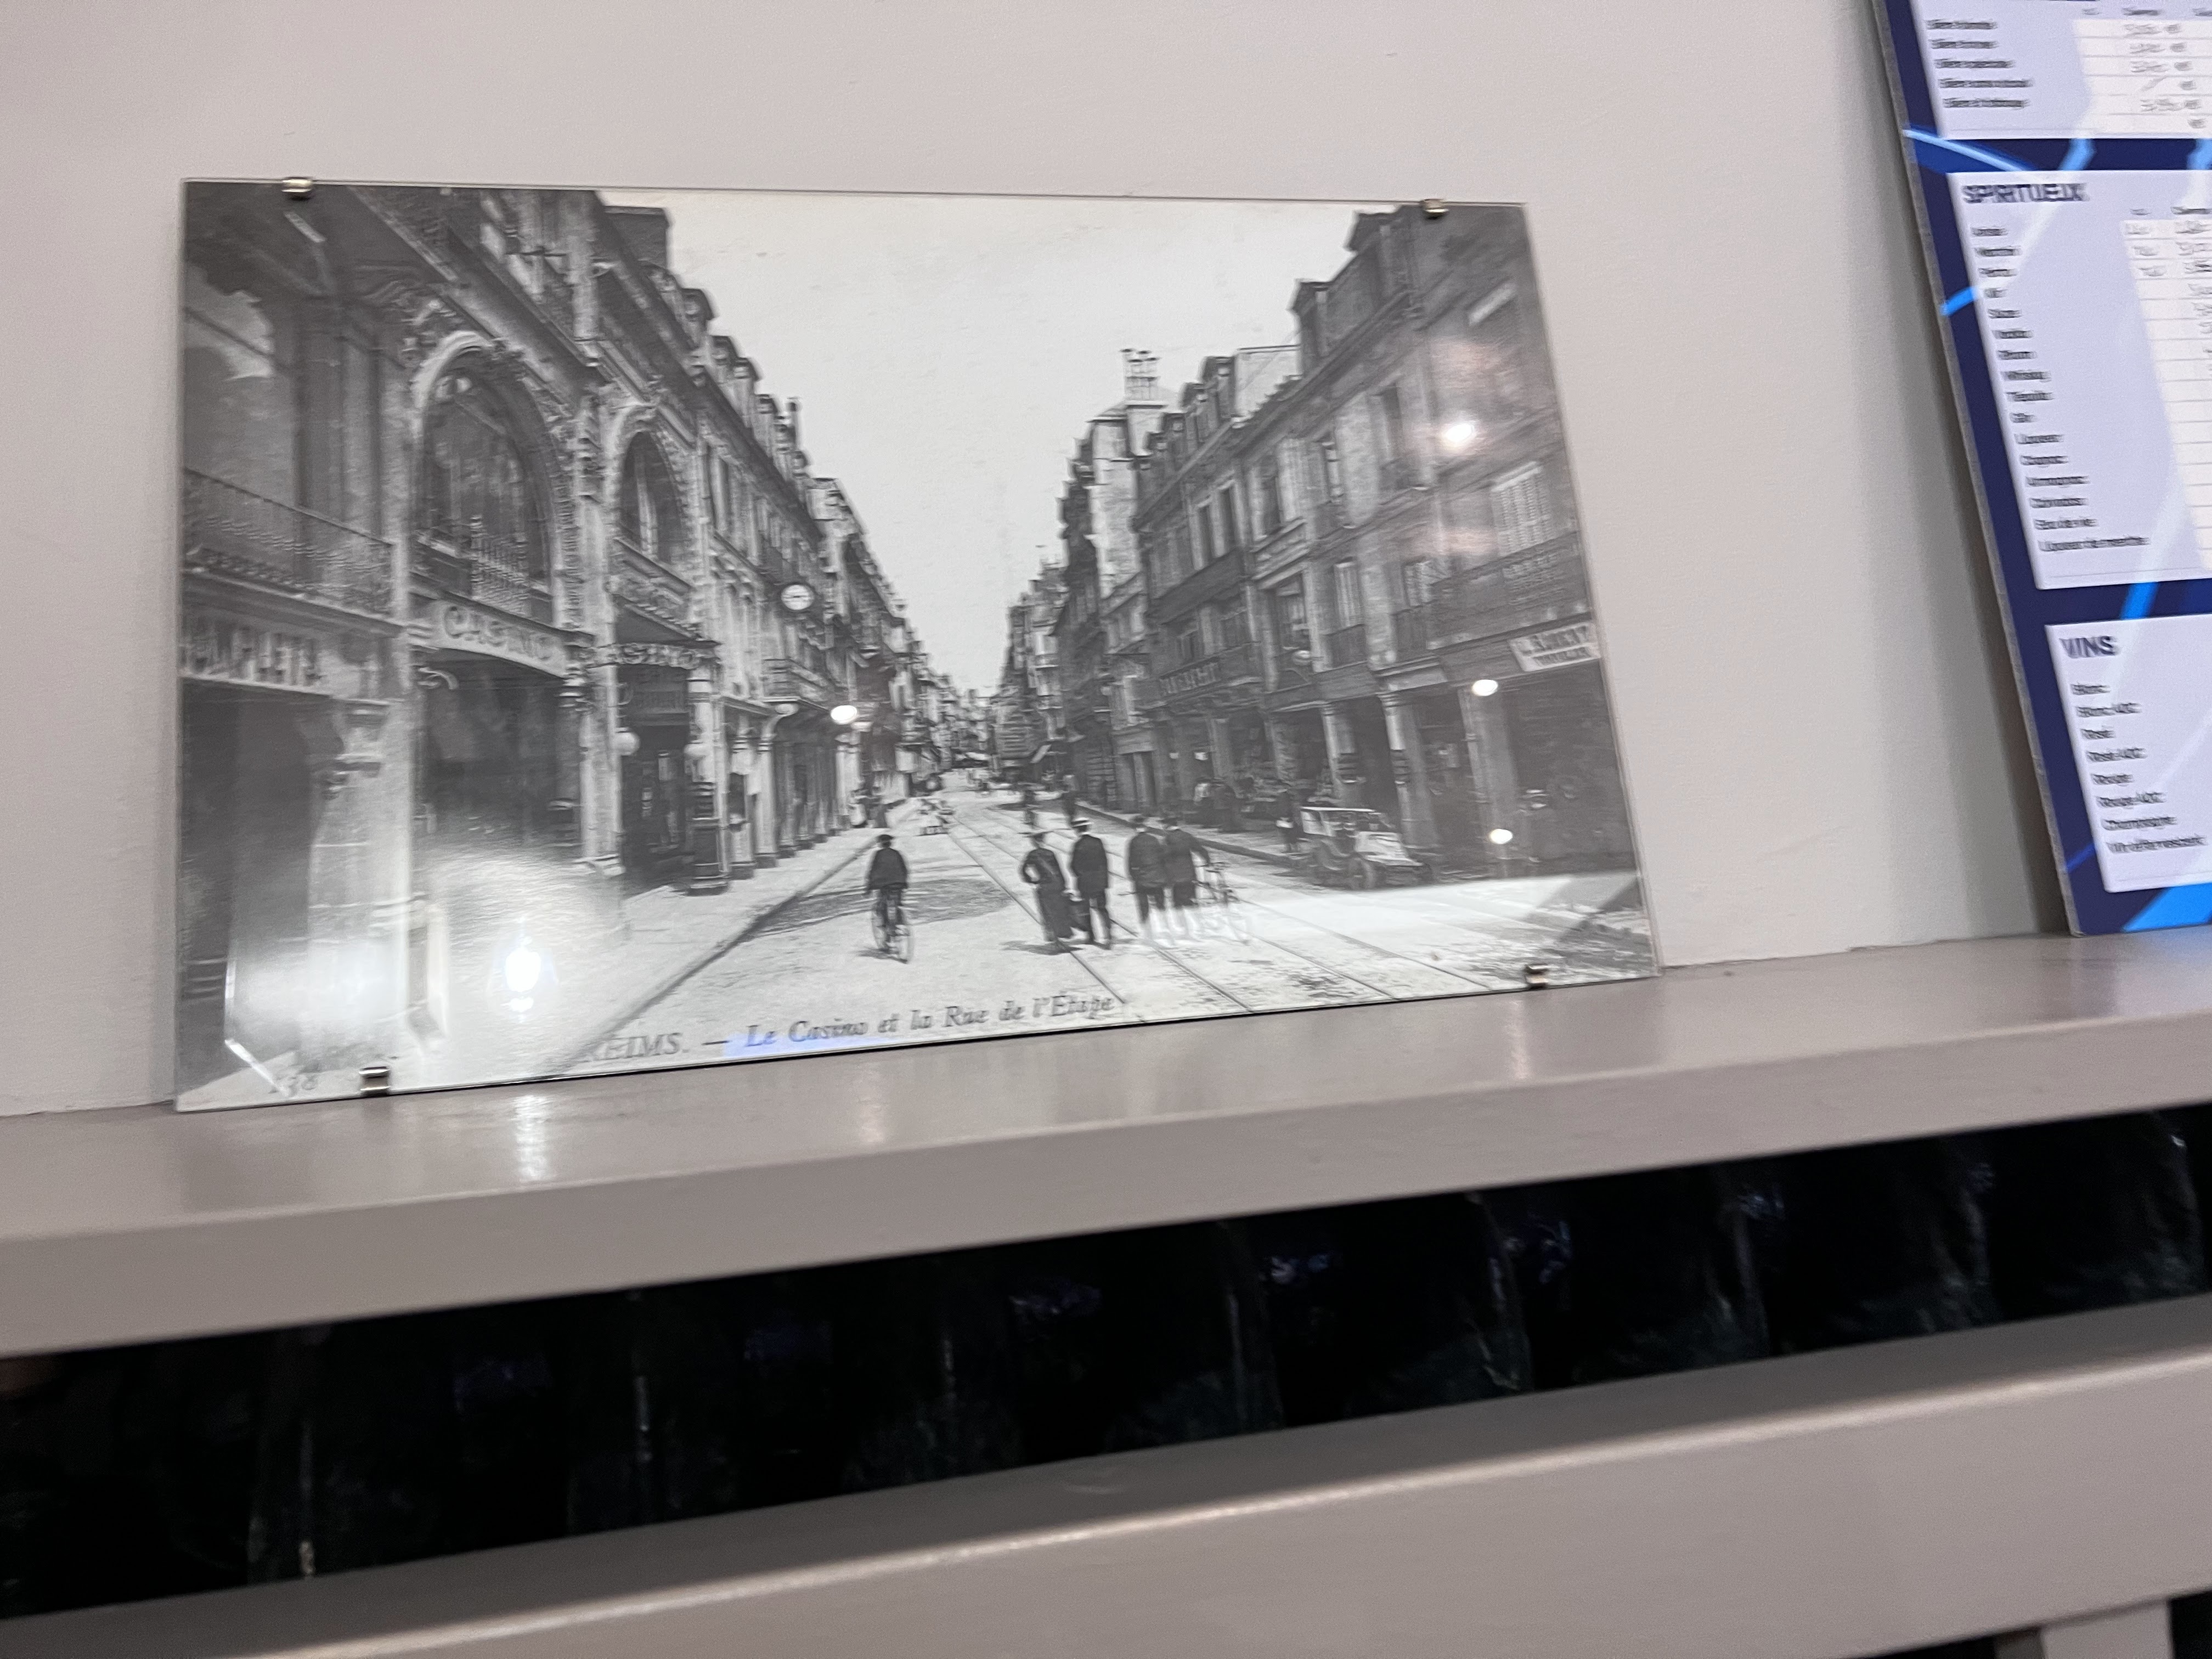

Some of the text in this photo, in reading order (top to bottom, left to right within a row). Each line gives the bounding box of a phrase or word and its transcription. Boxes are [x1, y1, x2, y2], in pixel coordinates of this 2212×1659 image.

[2059, 635, 2121, 658] VINS
[744, 1025, 777, 1047] Le
[788, 1018, 869, 1042] Casino
[877, 1013, 901, 1033] et
[910, 1009, 933, 1030] la
[942, 1006, 989, 1027] Rue
[998, 1000, 1025, 1021] de
